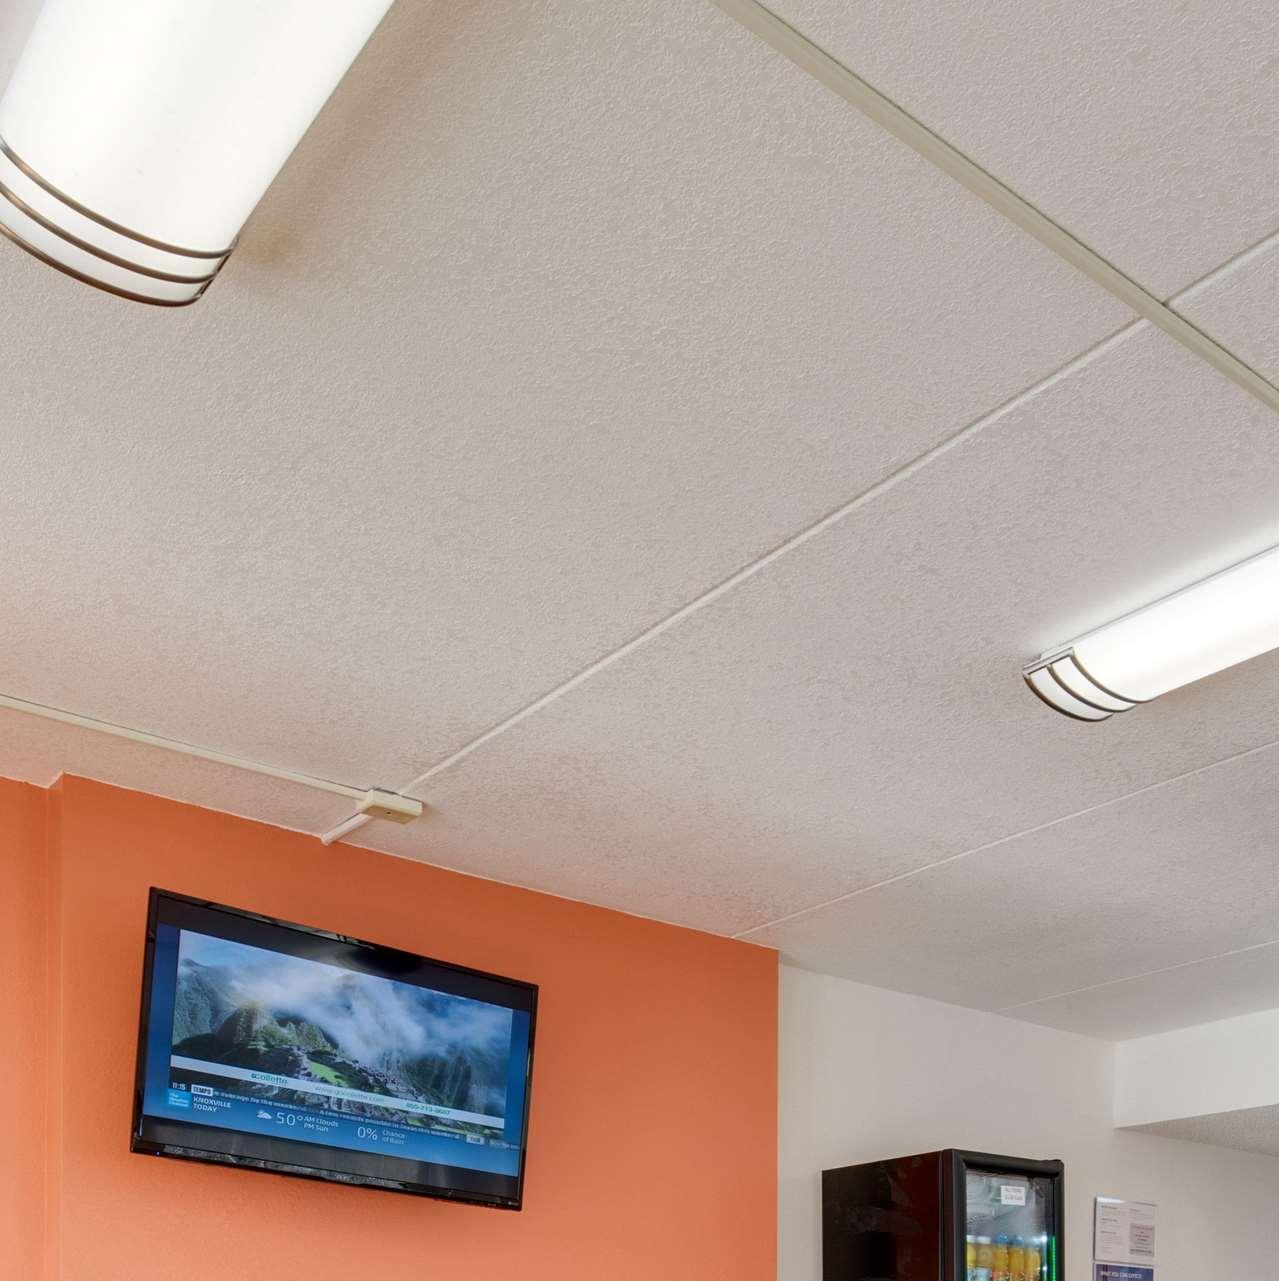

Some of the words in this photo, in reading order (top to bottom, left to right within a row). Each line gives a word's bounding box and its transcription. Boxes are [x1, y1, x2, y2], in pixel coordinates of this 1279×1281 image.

[192, 1095, 232, 1109] KNOXVILLE
[192, 1102, 218, 1113] TODAY
[304, 1115, 316, 1124] AM
[303, 1122, 315, 1130] PM
[357, 1126, 378, 1141] 0%
